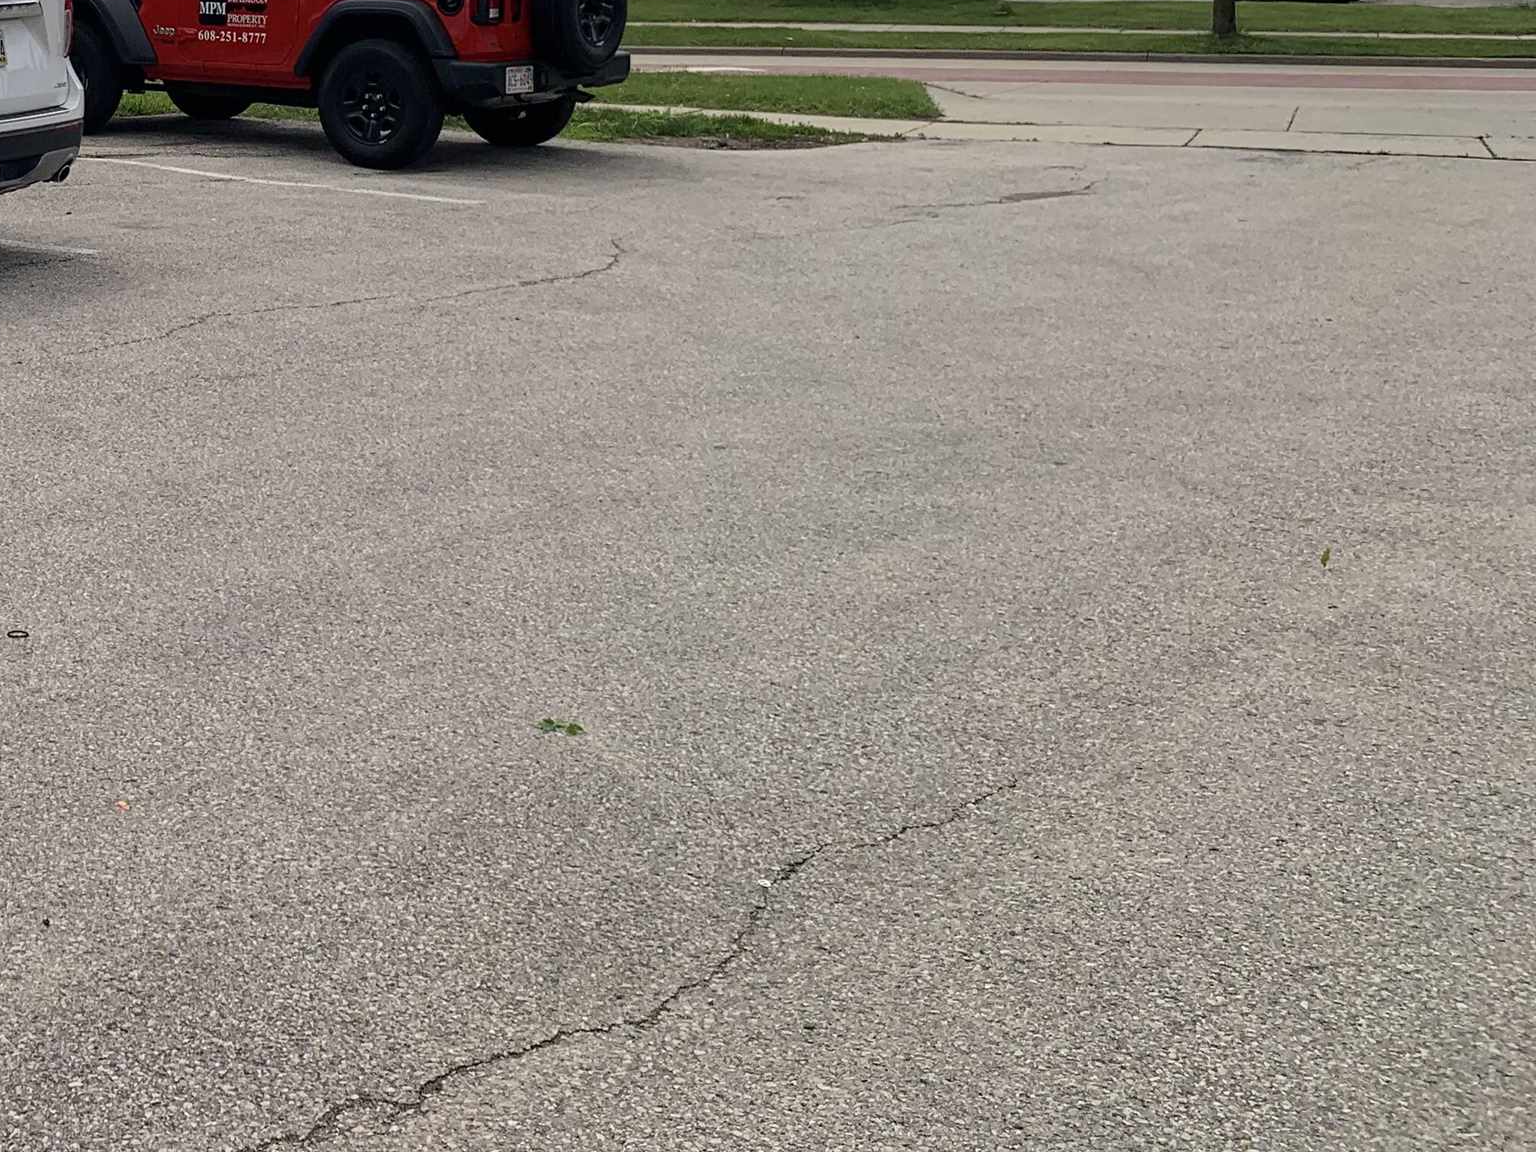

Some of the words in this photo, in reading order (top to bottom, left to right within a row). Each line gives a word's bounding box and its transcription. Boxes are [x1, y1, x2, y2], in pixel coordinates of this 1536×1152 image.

[199, 1, 227, 16] MPM
[227, 13, 268, 24] PROPERTY
[198, 30, 267, 45] 608-251-8777
